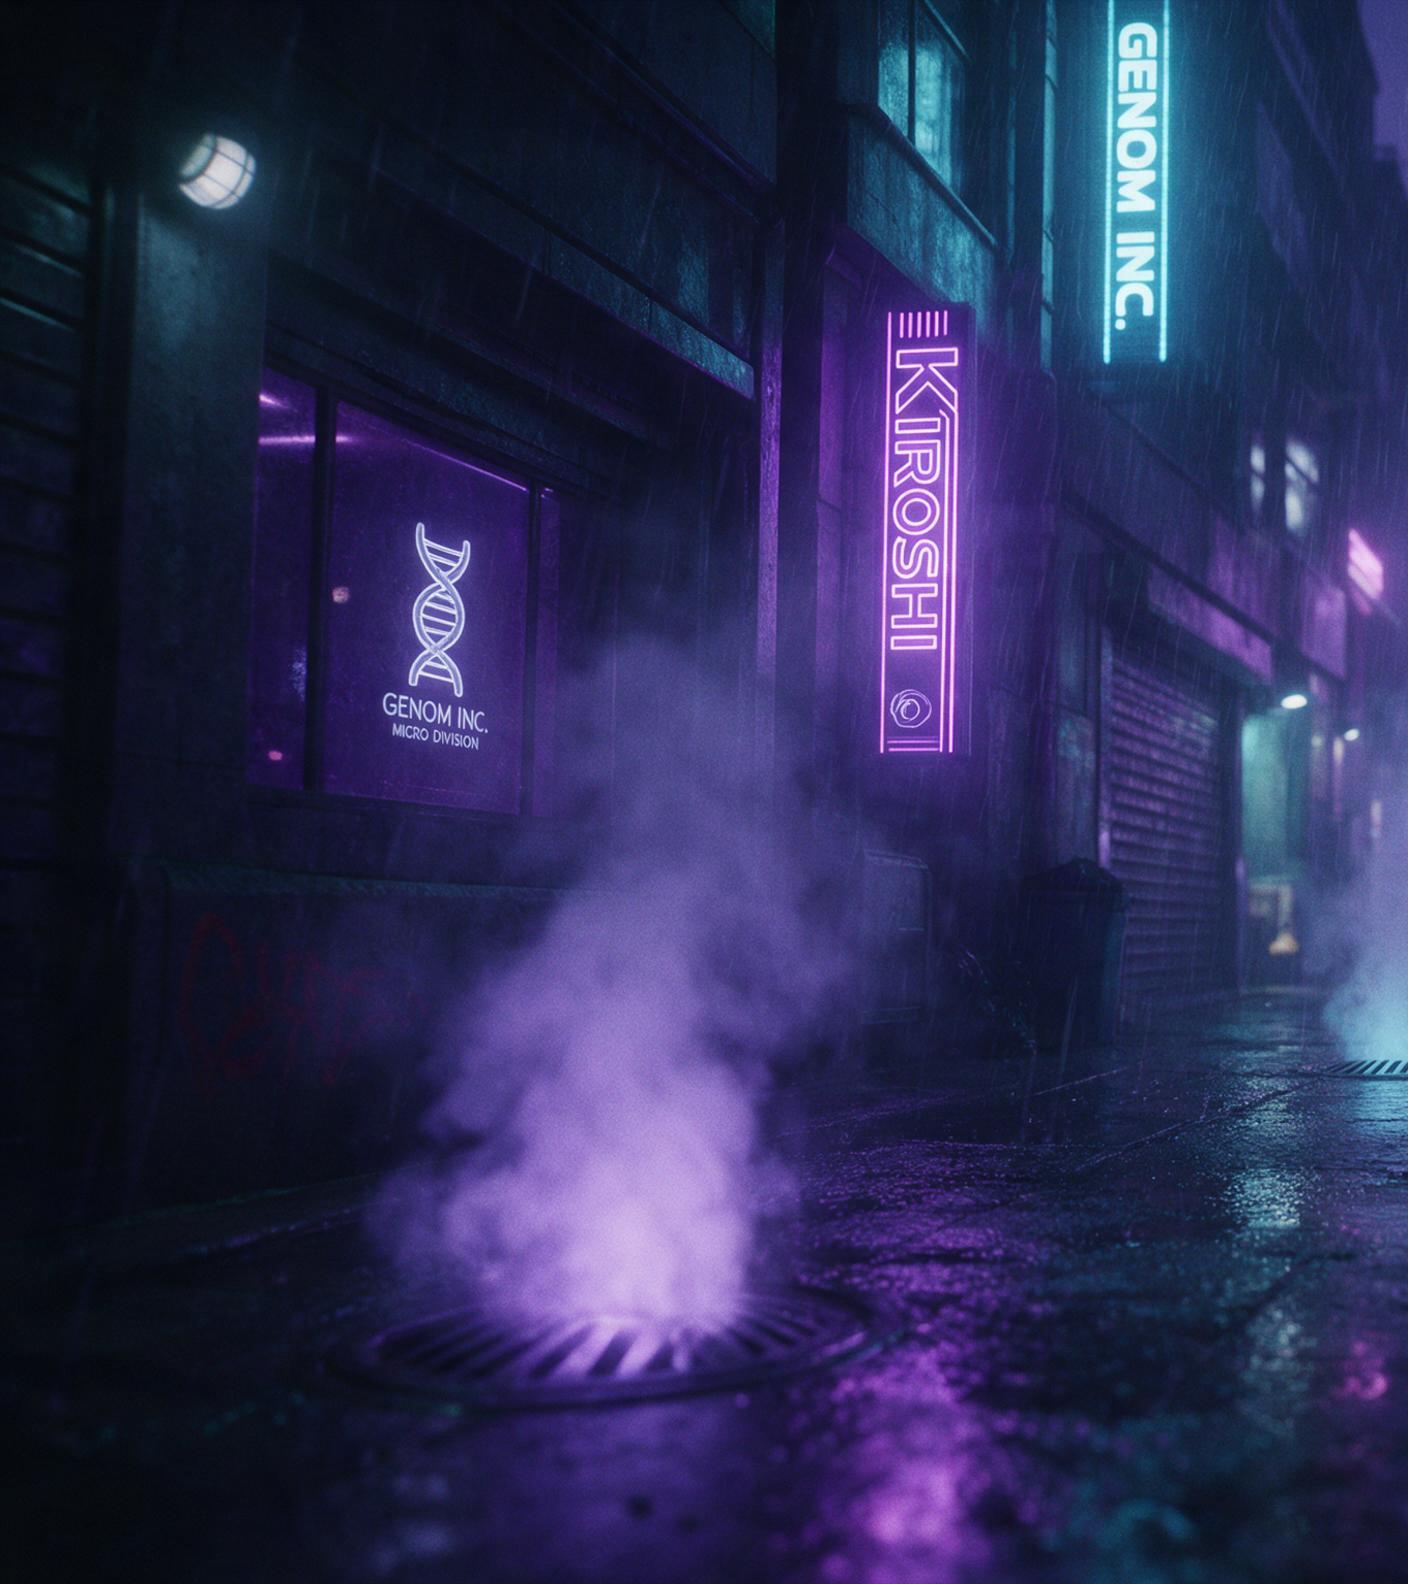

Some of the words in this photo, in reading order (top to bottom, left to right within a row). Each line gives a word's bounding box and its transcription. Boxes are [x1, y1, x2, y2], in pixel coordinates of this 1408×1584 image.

[1116, 22, 1158, 213] GENOM
[1114, 231, 1155, 331] INC.
[890, 346, 959, 650] KIROSHI
[382, 692, 452, 728] GENOM
[457, 706, 489, 734] INC.
[392, 722, 429, 742] MICRO
[433, 728, 480, 750] DIVISION
